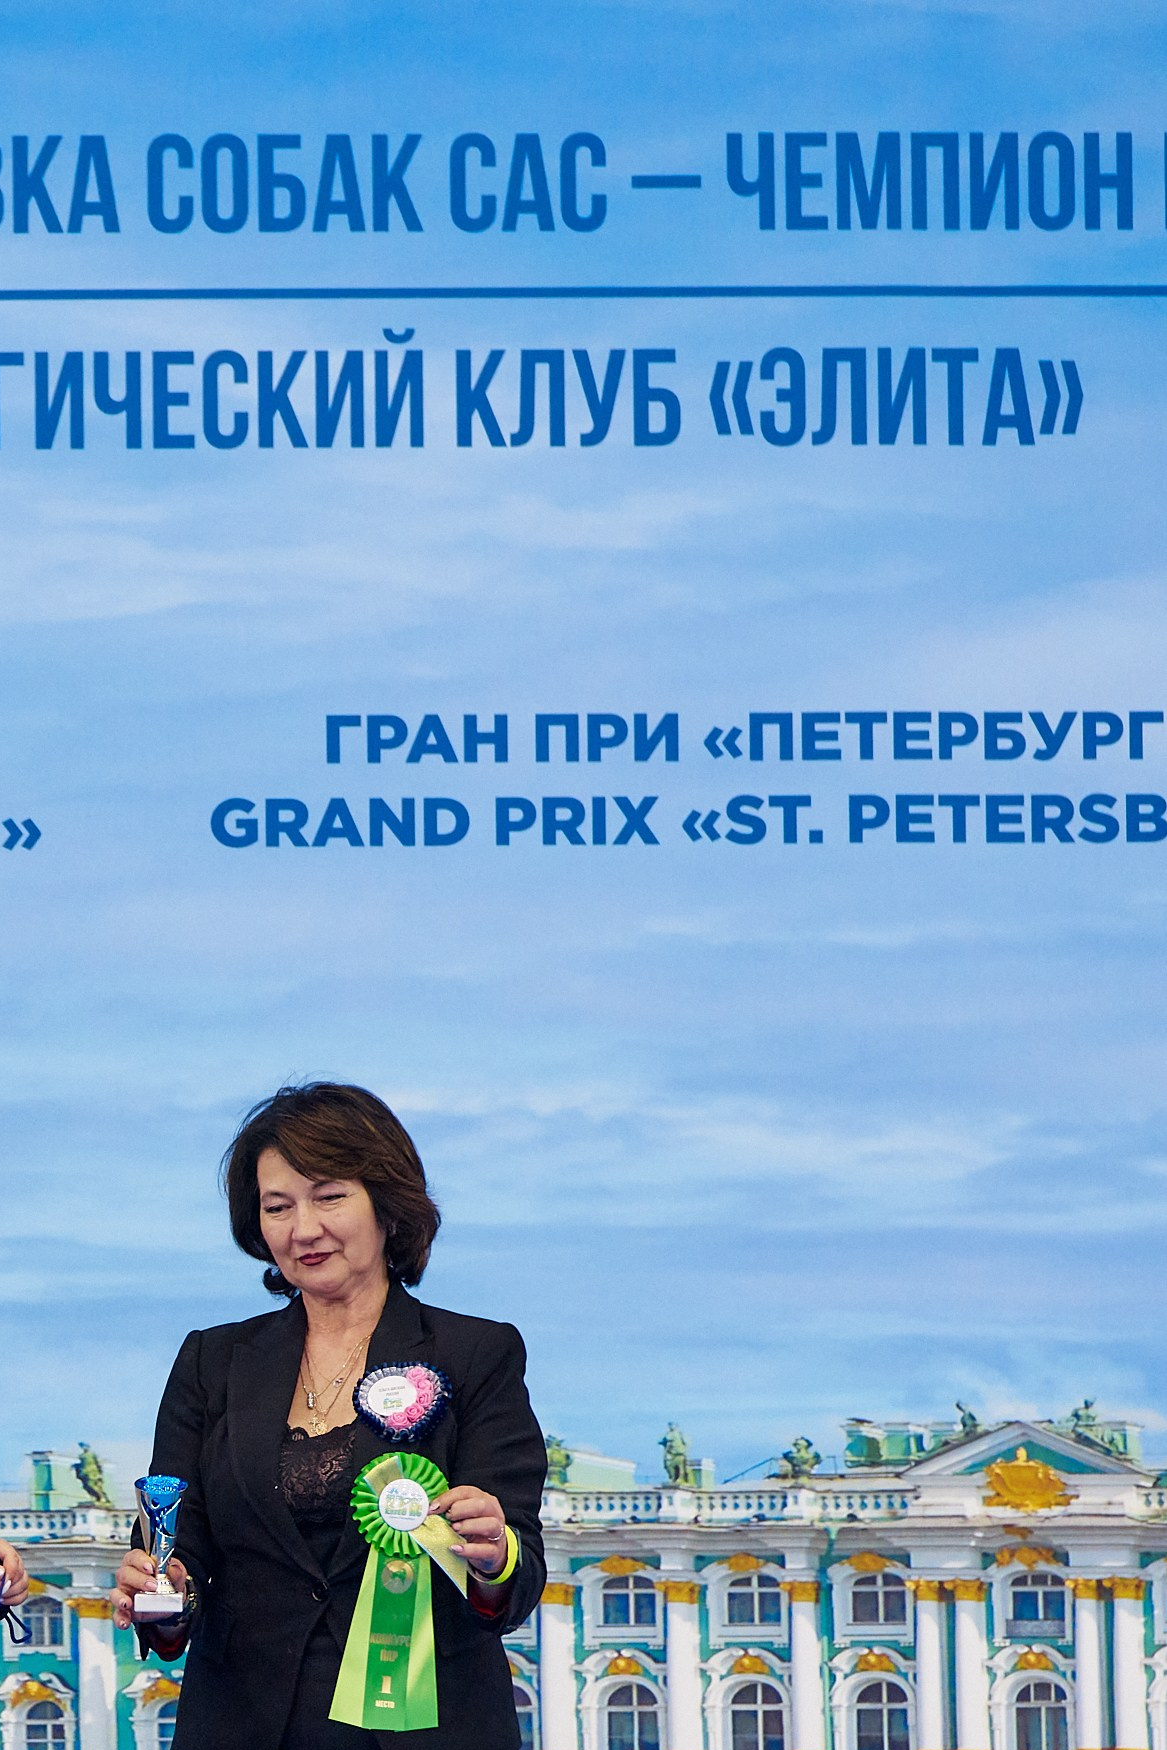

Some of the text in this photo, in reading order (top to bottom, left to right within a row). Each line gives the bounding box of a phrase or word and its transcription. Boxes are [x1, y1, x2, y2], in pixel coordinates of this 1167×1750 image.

[146, 132, 425, 234] СОБАК
[725, 130, 1134, 232] ЧЕМПИОН
[456, 348, 681, 447] КЛУБ
[709, 346, 1083, 447] «ЭЛИТА»
[326, 712, 1164, 764] ГРАН ПРИ «ПЕТЕРБУРГ
[211, 798, 469, 848] GRAND
[496, 796, 659, 846] PRIX
[682, 795, 823, 845] «ST.
